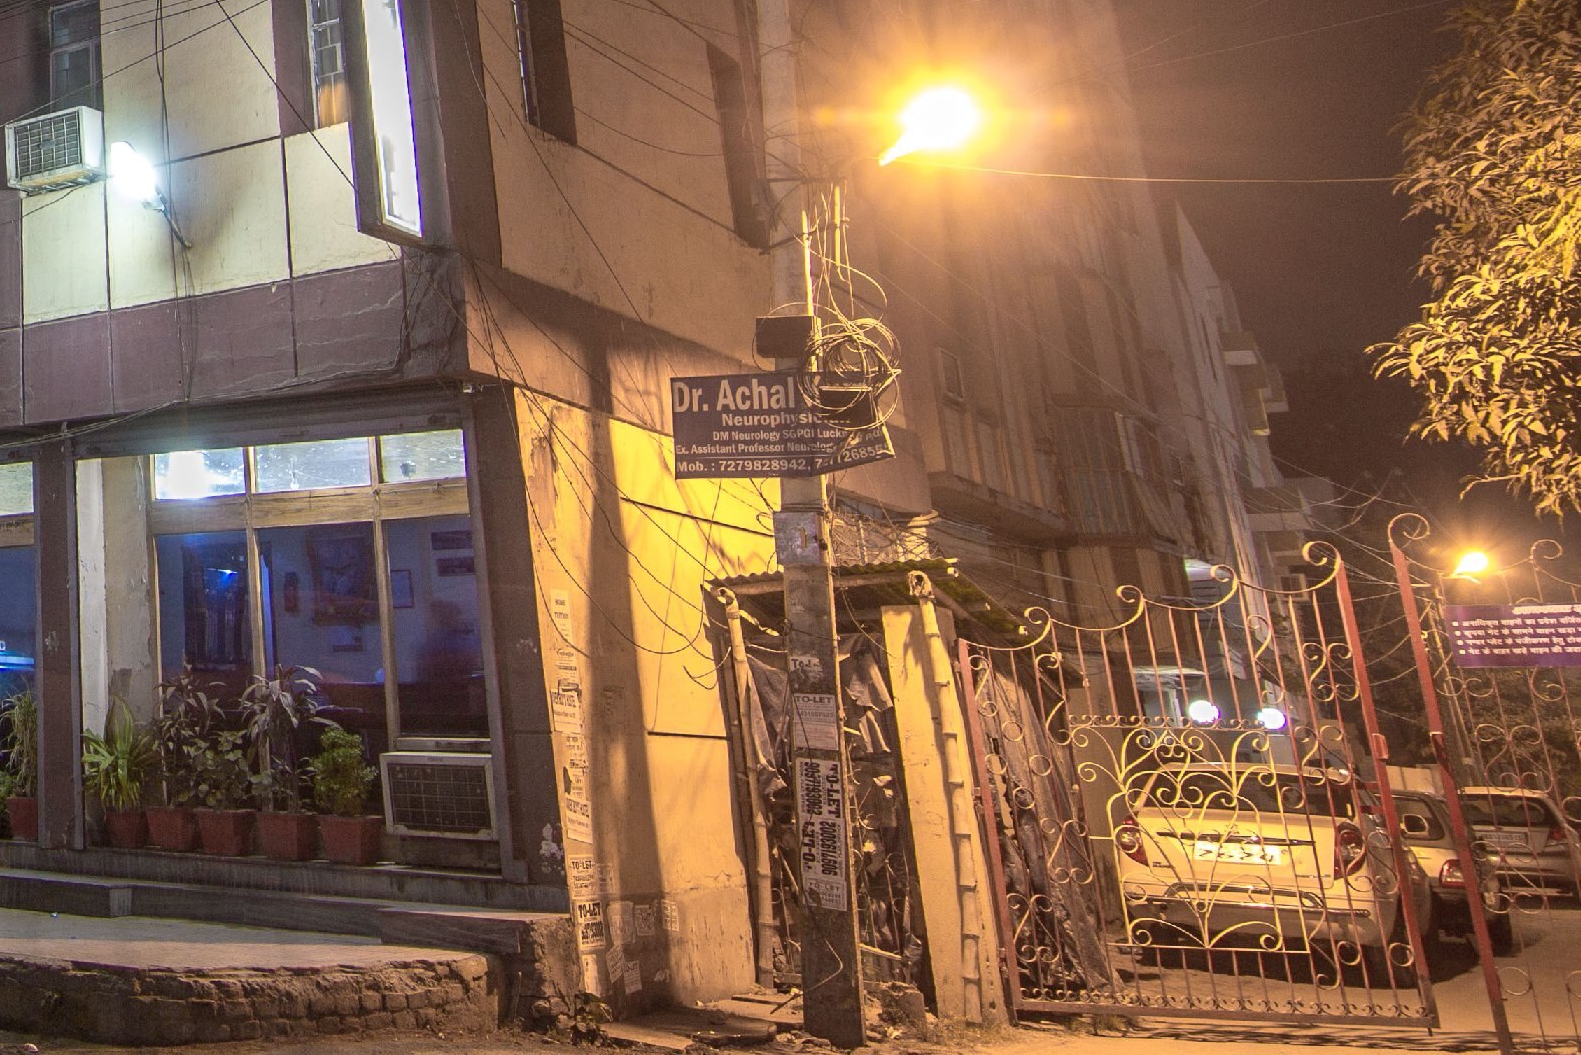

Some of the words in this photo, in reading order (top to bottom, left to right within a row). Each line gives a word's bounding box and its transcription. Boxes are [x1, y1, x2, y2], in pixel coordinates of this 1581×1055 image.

[673, 380, 709, 413] Dr.
[716, 376, 795, 412] Achal
[712, 431, 729, 441] DM
[731, 430, 780, 442] Neurology
[782, 428, 815, 439] SGPGI
[676, 445, 690, 455] Ex.
[691, 444, 736, 455] Assistant
[738, 443, 786, 453] Professor
[677, 460, 708, 473] Mob.
[796, 695, 833, 704] TO-LET
[826, 763, 841, 819] TO-LET
